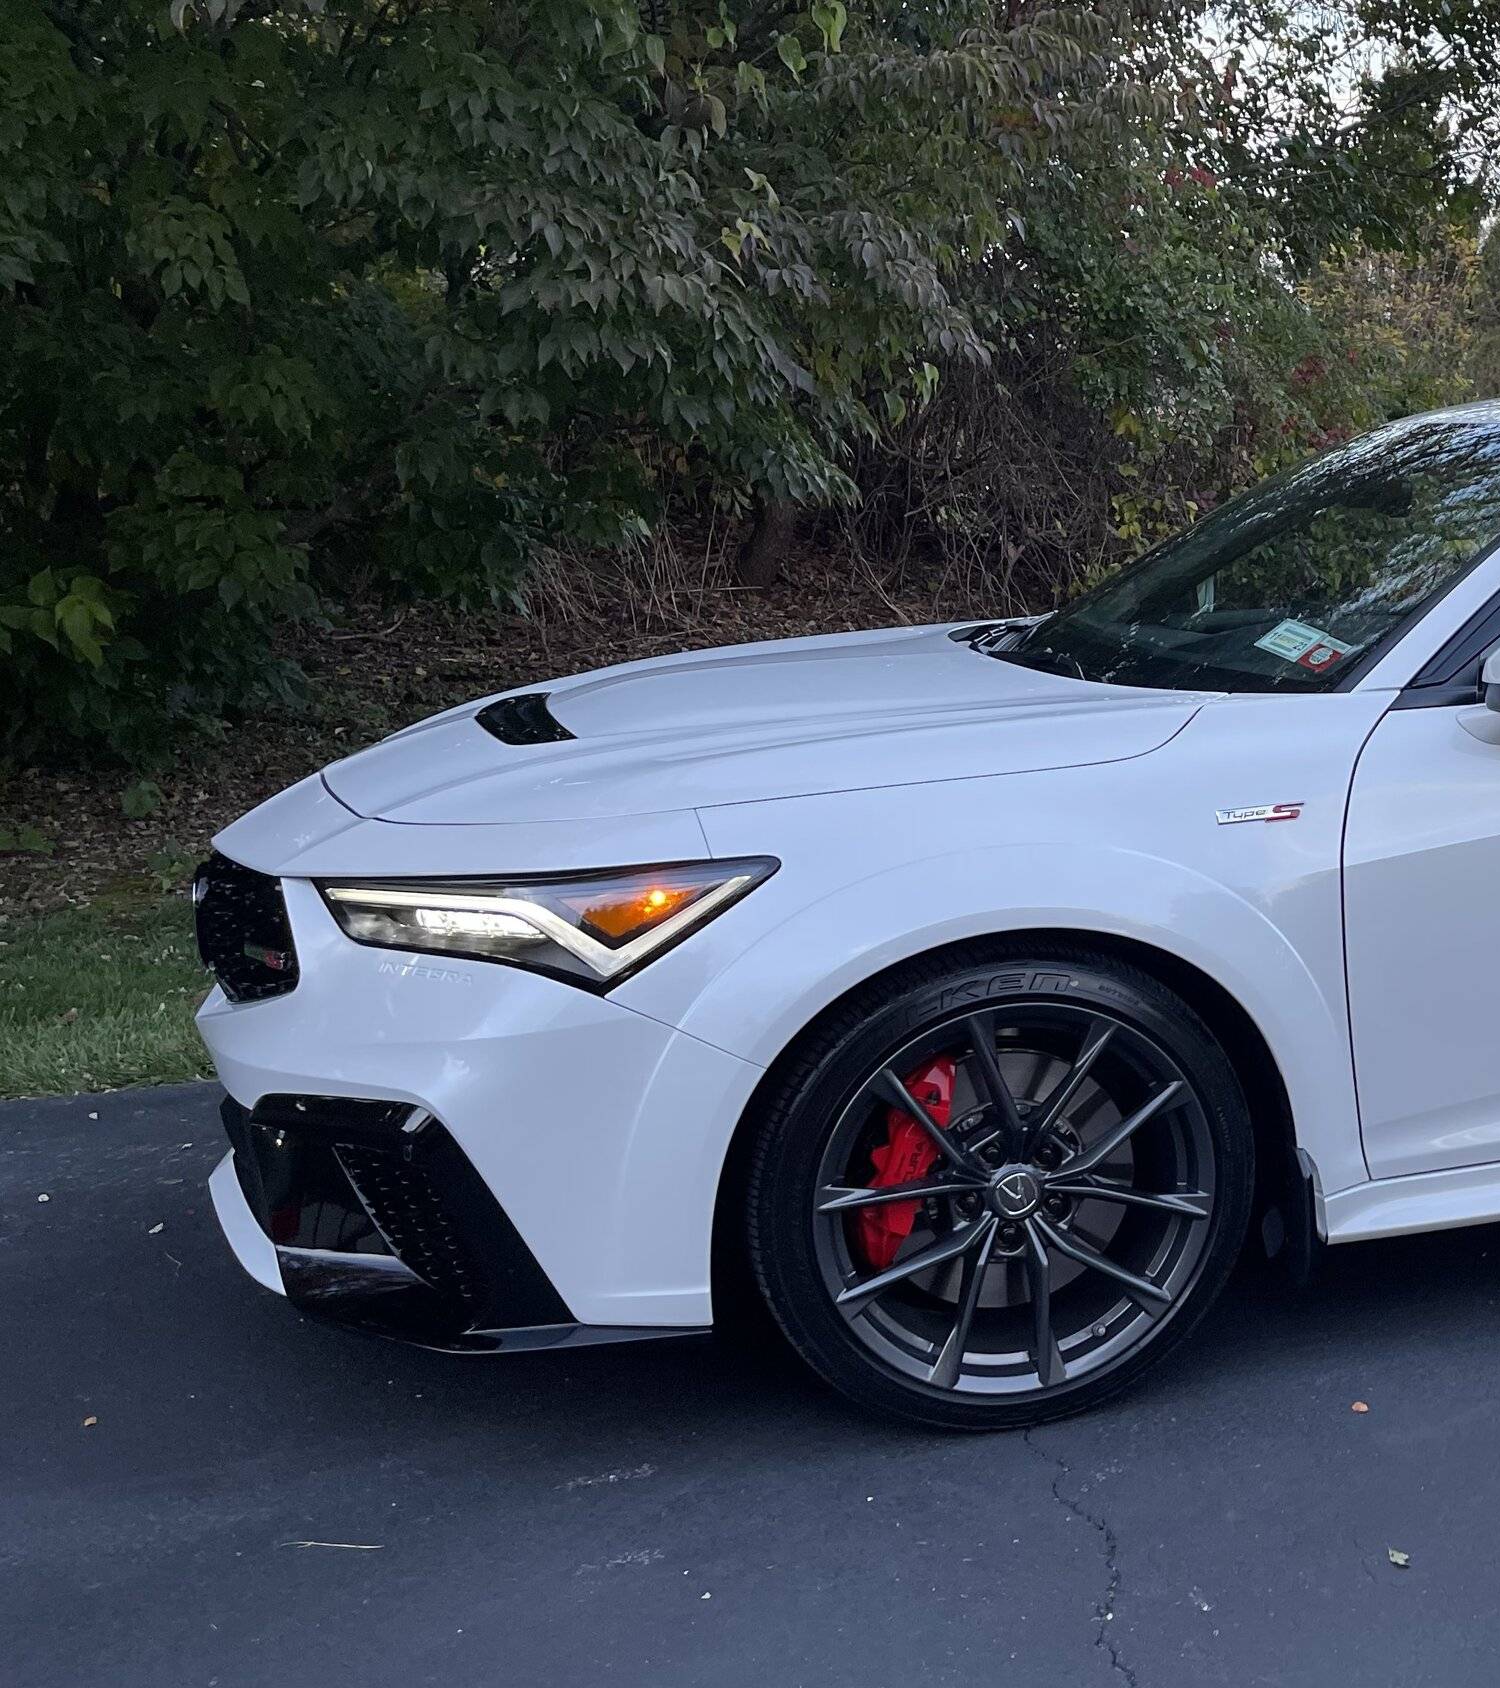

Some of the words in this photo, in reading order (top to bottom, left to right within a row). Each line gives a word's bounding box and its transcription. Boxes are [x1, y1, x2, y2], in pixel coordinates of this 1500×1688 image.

[1222, 810, 1267, 820] Type
[1265, 802, 1305, 823] S
[378, 962, 473, 986] INTEGRA
